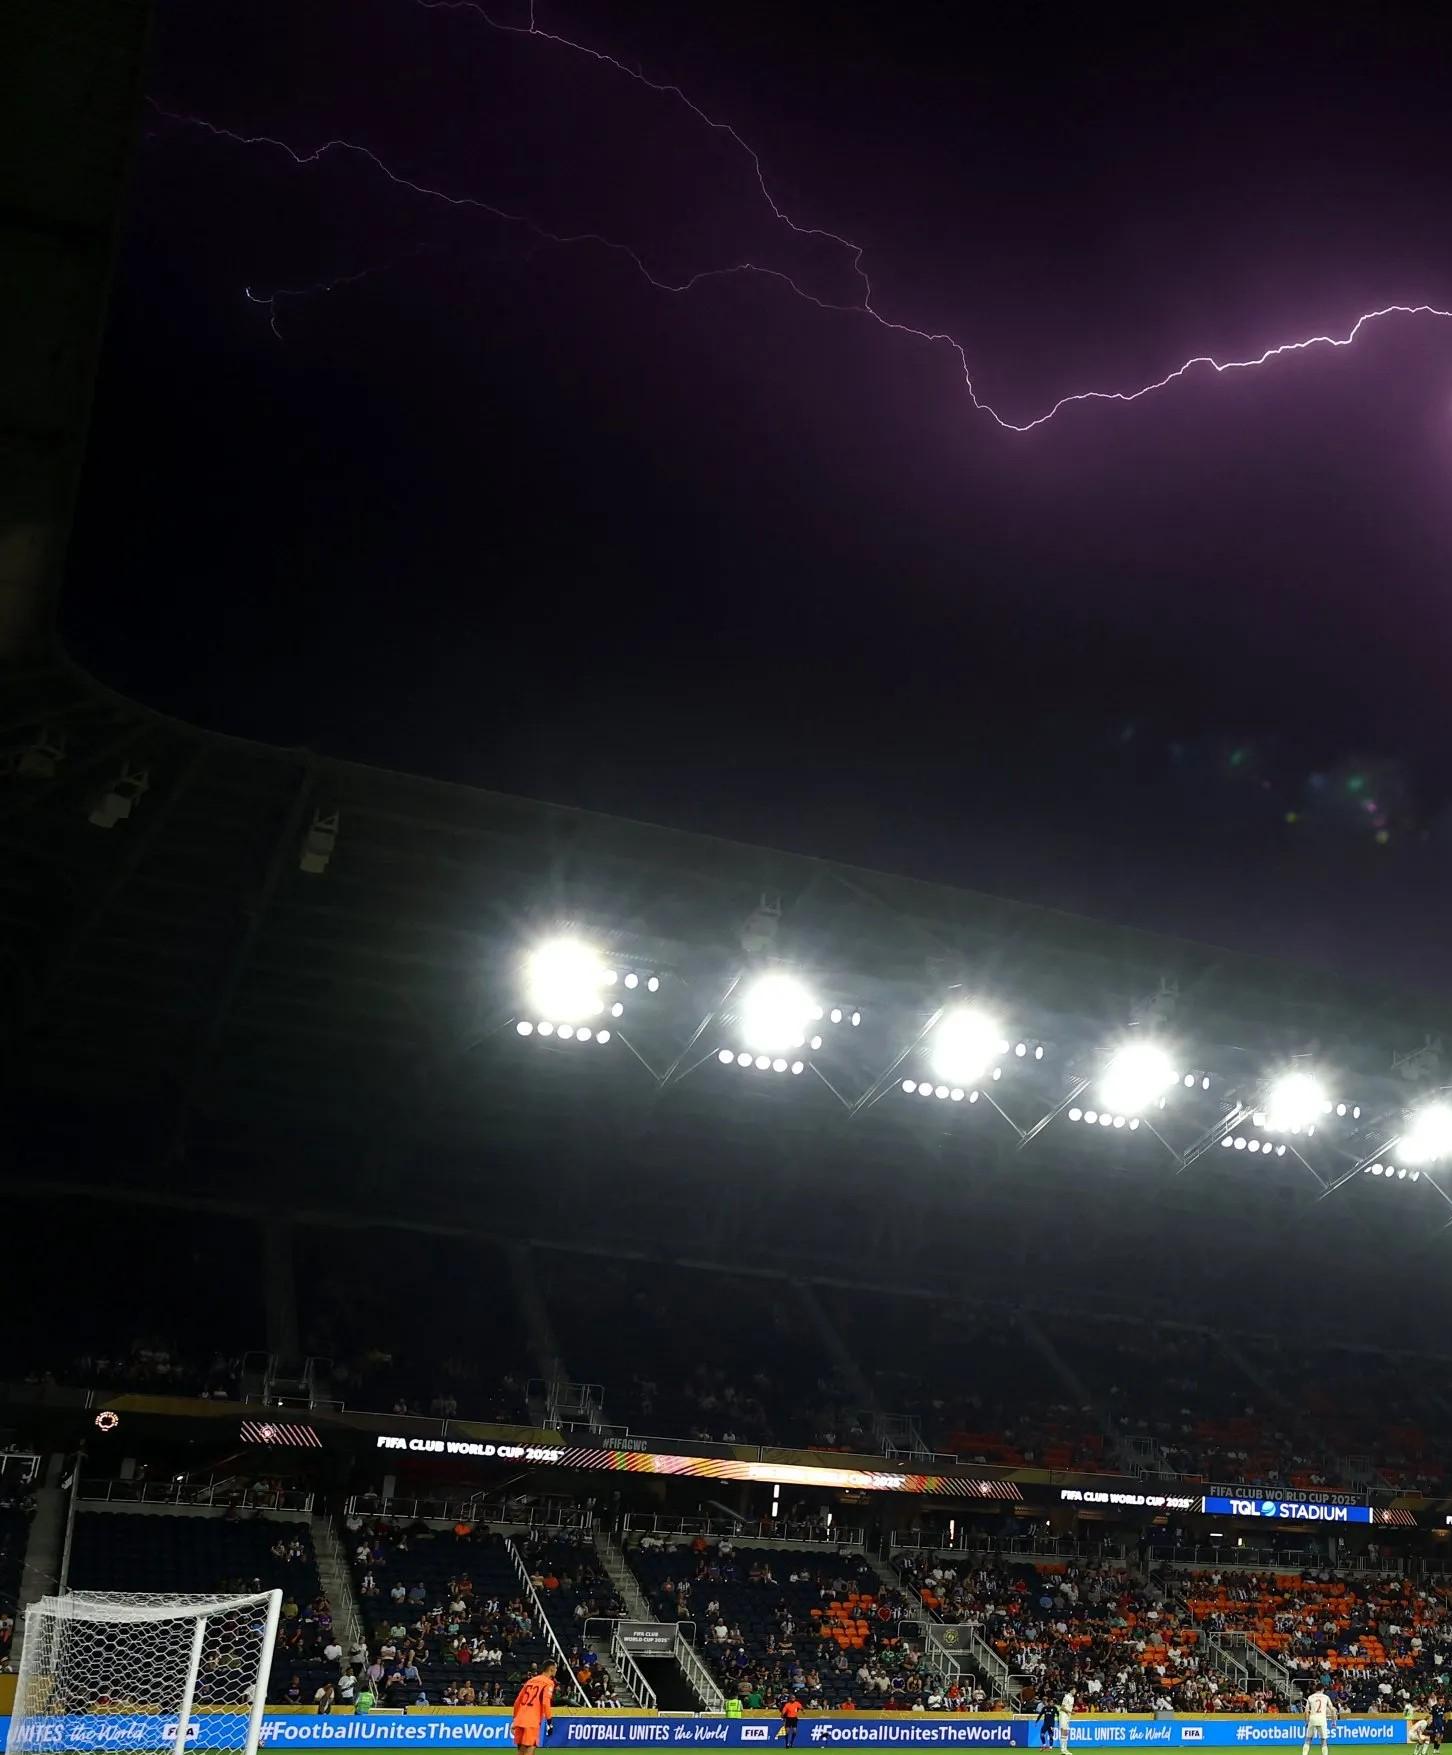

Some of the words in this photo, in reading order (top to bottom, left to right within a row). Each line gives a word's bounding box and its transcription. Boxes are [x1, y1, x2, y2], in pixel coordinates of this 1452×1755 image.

[377, 1437, 407, 1450] FIFA
[409, 1439, 444, 1453] CLUB
[446, 1441, 496, 1457] WORLD
[497, 1445, 524, 1459] CUP
[1061, 1490, 1083, 1502] FIFA
[1084, 1491, 1109, 1503] CLUB
[1110, 1493, 1145, 1506] WORLD
[1146, 1495, 1165, 1507] CUP
[1210, 1486, 1233, 1497] FIFA
[1235, 1488, 1263, 1500] CLUB
[1264, 1489, 1307, 1502] WORLD
[1309, 1492, 1329, 1504] CUP
[1229, 1500, 1260, 1517] TQL
[1280, 1503, 1348, 1522] STADIUM
[519, 1684, 539, 1706] 52
[1315, 1698, 1322, 1714] 2
[568, 1724, 627, 1741] FOOTBALL
[629, 1724, 670, 1741] UNITES
[673, 1725, 694, 1740] the
[694, 1724, 729, 1741] World
[743, 1728, 766, 1738] FIFA
[810, 1724, 1011, 1742] #FootballUnitesTheWorld
[1095, 1727, 1126, 1741] UNITES
[1129, 1727, 1144, 1741] the
[1145, 1726, 1172, 1741] World
